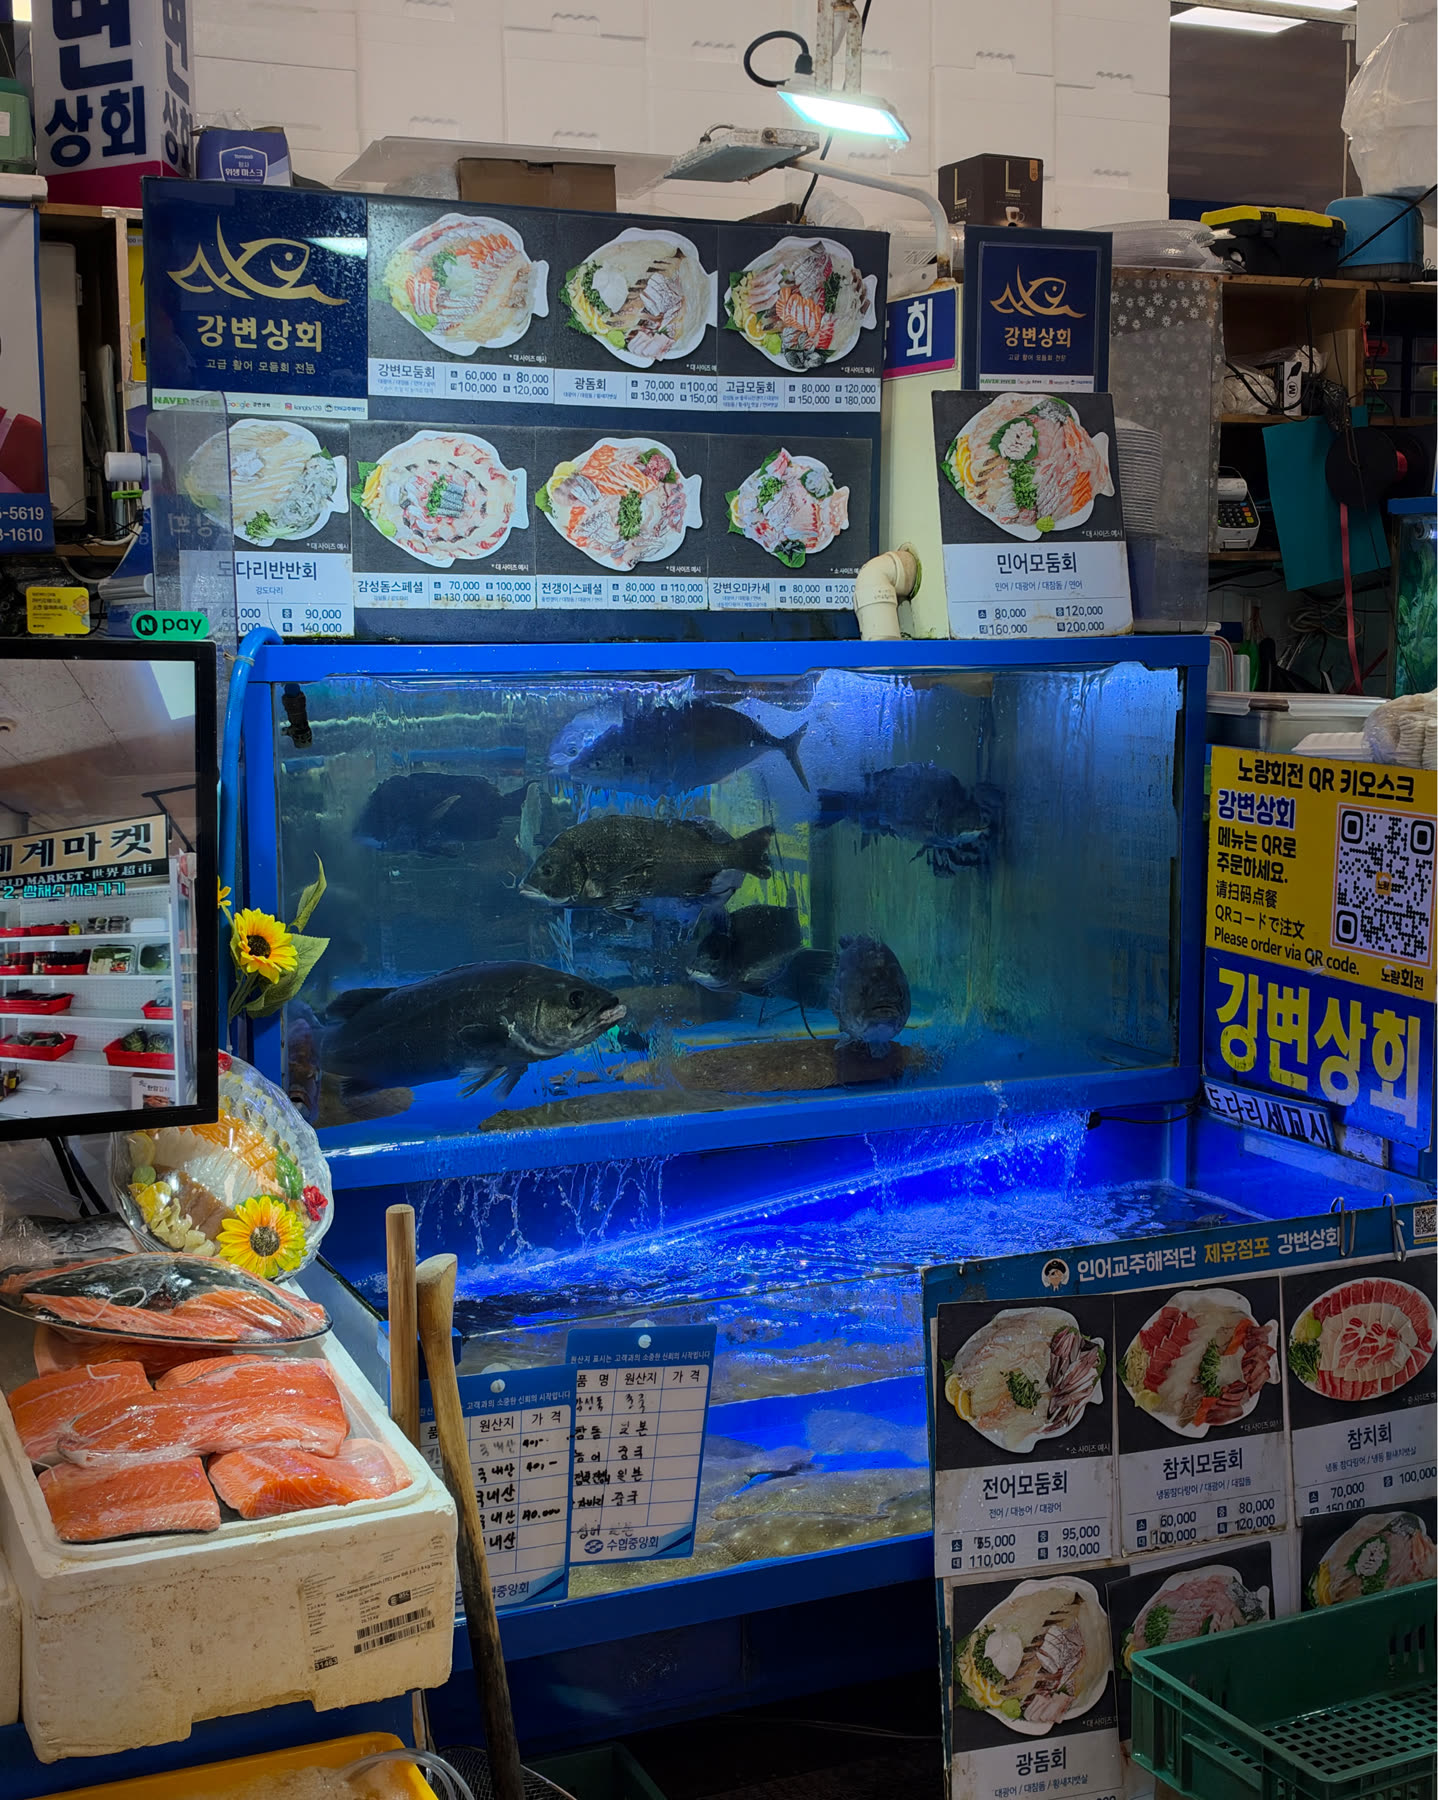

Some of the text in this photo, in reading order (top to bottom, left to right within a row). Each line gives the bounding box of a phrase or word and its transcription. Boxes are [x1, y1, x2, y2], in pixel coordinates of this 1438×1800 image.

[44, 86, 146, 168] 상회
[197, 314, 322, 353] 강변상회
[906, 298, 933, 358] 회
[1004, 327, 1072, 348] 강변상회
[206, 359, 227, 370] 고급
[232, 360, 253, 372] 활어
[378, 363, 435, 380] 강변모둠회
[465, 370, 549, 384] 60,000 80,000
[574, 377, 607, 391] 광돔회
[645, 380, 675, 391] 70,000
[459, 382, 497, 394] 100,000
[514, 385, 549, 397] 120,000
[726, 381, 776, 394] 고급모둠회
[802, 384, 877, 395] 80,000 120,000
[640, 392, 675, 403] 130,000
[799, 396, 876, 406] 150,000 180,000
[218, 560, 317, 581] 도다리반반회
[997, 552, 1077, 575] 민어모둠회
[256, 586, 284, 595] 강도다리
[358, 581, 424, 594] 감성돔스페셜
[450, 581, 531, 593] 70,000 100,000
[541, 583, 602, 595] 전갱이스페셜
[626, 583, 704, 593] 80,000 110,000
[713, 582, 771, 594] 강변오마카세
[793, 585, 821, 594] 80,000
[1015, 582, 1036, 591] 대광어
[1069, 581, 1083, 590] 연어
[444, 593, 480, 604] 130,000
[496, 594, 531, 605] 160,000
[670, 595, 704, 605] 180,000
[789, 596, 821, 606] 160,000
[305, 609, 342, 620] 90,000
[978, 609, 987, 619] 소
[995, 608, 1027, 620] 80,000
[1065, 606, 1103, 617] 120,000
[162, 618, 202, 635] pay
[301, 623, 342, 634] 140,000
[989, 624, 1028, 636] 160,000
[1067, 621, 1105, 633] 200,000
[1238, 758, 1415, 803] 노량회전 QR 키오스크
[1217, 789, 1296, 830] 강변상회
[1218, 826, 1297, 859] 메뉴는 QR로
[92, 863, 153, 880] 世界超市
[1216, 852, 1289, 884] 주문하세요.
[27, 870, 85, 886] MARKET
[4, 881, 126, 900] 2. 쌈채소 사러가기
[1216, 880, 1278, 910] 请扫码点餐
[1215, 904, 1305, 941] QRコードで注文
[1214, 926, 1360, 976] Please order via QR code.
[1381, 967, 1424, 990] 노량회전
[1216, 967, 1421, 1129] 강변상회
[1078, 1226, 1341, 1283] 인어교주해적단 제휴점포 강변상회
[592, 1354, 613, 1364] 표시는
[615, 1353, 641, 1363] 고객과의
[642, 1352, 661, 1362] 소중한
[577, 1370, 701, 1387] 품 명 원산지 가 격
[467, 1399, 495, 1410] 고객과의
[479, 1416, 515, 1433] 원산지
[532, 1412, 544, 1426] 가
[551, 1410, 562, 1424] 격
[1348, 1422, 1393, 1451] 참치회
[1163, 1448, 1243, 1481] 참치모둠회
[982, 1470, 1068, 1501] 전어모둠회
[1204, 1480, 1226, 1492] 대광어
[1309, 1491, 1319, 1503] 소
[1331, 1482, 1365, 1499] 70,000
[1400, 1466, 1437, 1484] 100,000
[989, 1502, 1062, 1519] 전어 대농어 대광어
[1136, 1498, 1275, 1532] 소 60,000 중 80,000
[952, 1525, 1101, 1552] 소 중 95,000
[1137, 1536, 1147, 1548] 대
[1152, 1528, 1197, 1545] 100,000
[1235, 1514, 1276, 1531] 120,000
[606, 1536, 659, 1552] 수협중앙회
[952, 1557, 962, 1570] 대
[969, 1552, 1016, 1568] 110,000
[1056, 1542, 1101, 1559] 130,000
[1016, 1747, 1067, 1777] 광돔회
[994, 1786, 1017, 1798] 대광어
